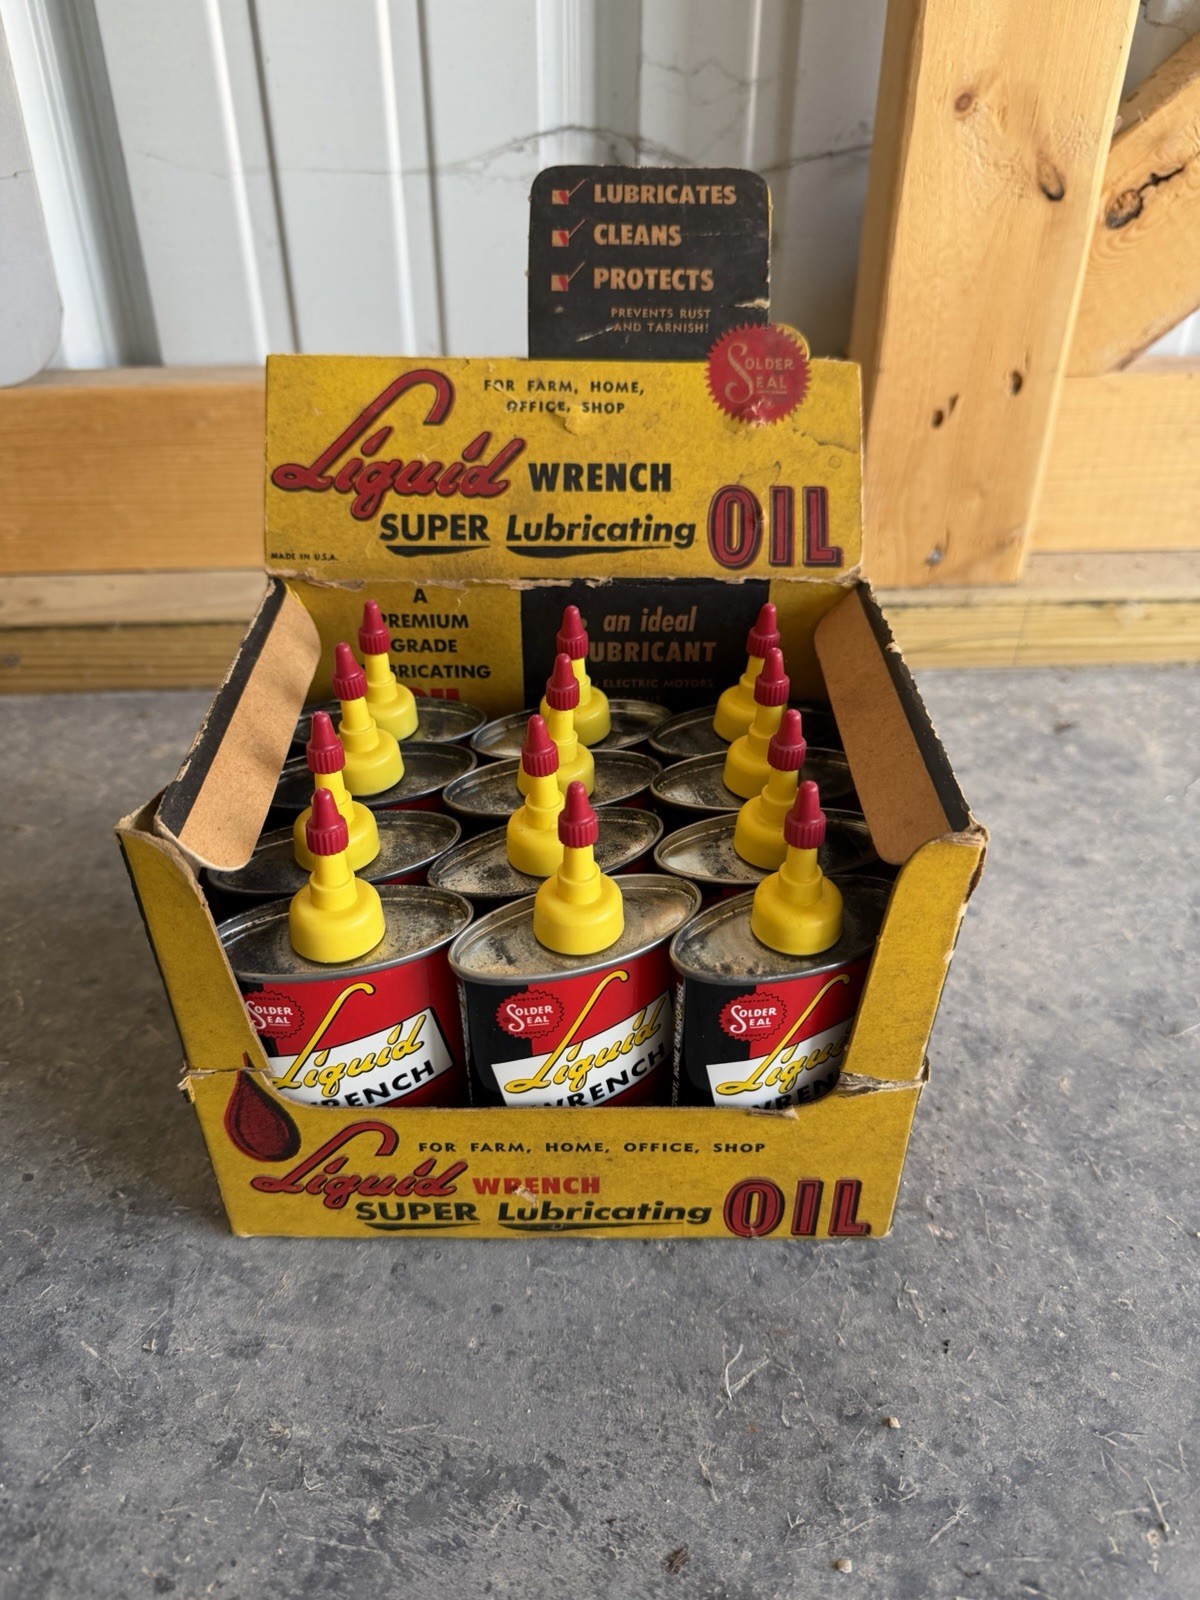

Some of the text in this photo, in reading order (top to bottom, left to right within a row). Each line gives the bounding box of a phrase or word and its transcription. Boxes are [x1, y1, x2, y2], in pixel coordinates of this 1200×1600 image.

[594, 184, 737, 206] LUBRICATES
[594, 224, 682, 246] CLEANS
[593, 268, 714, 291] PROTECTS
[610, 307, 711, 320] PREVENTS RUST
[613, 322, 709, 333] AND TARNISH!
[724, 343, 796, 404] SOLDER
[484, 379, 644, 396] FOR FARM, HOME,
[506, 401, 625, 415] OFFICE, SHOP
[271, 368, 672, 521] Liquid WRENCH
[379, 485, 844, 569] SUPER Lubricating OIL
[270, 552, 339, 562] MADE IN U.S.A.
[413, 588, 428, 603] A
[603, 606, 698, 632] an ideal
[391, 639, 458, 653] GRADE
[588, 641, 717, 663] UBRICANT
[390, 664, 491, 679] BRICATING
[603, 679, 658, 689] ELECTRIC
[245, 1000, 294, 1030] SOLDER
[506, 1003, 554, 1032] SOLDER
[730, 1005, 778, 1034] SOLDER
[273, 982, 427, 1098] Liquid
[504, 970, 667, 1093] Liquid
[715, 973, 850, 1095] Liqui
[418, 1142, 766, 1154] FOR FARM, HOME, OFFICE, SHOP
[250, 1119, 600, 1210] Liquid WRENCH
[355, 1176, 872, 1237] SUPER Lubricating OIL
